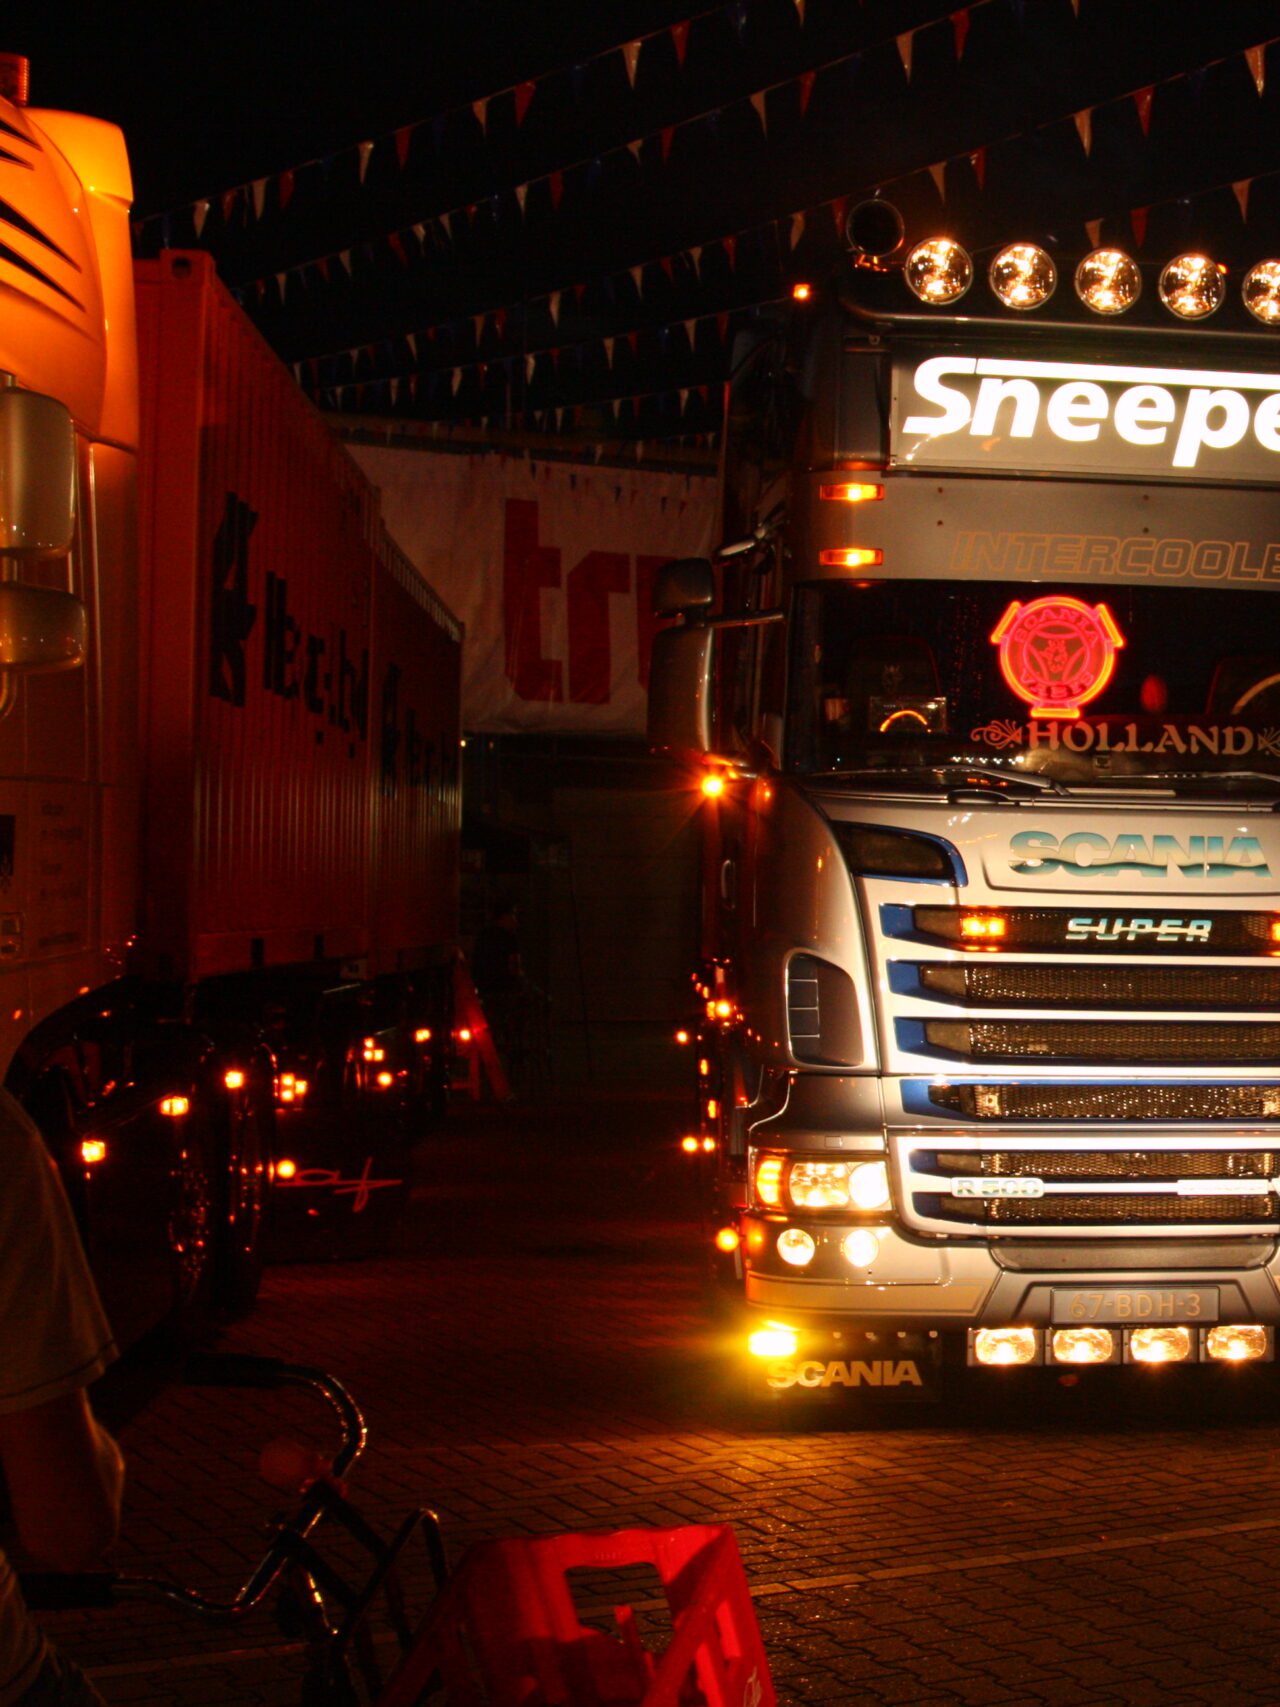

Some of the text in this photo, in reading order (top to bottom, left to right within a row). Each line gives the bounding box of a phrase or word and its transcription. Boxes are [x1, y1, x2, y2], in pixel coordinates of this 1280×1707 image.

[1025, 720, 1254, 756] HOLLAND
[1008, 829, 1273, 878] SCANIA
[1064, 917, 1213, 942] SUPER
[956, 1178, 1041, 1197] R 500
[1069, 1292, 1202, 1319] 67-BDH-3
[767, 1361, 923, 1388] SCANIA
